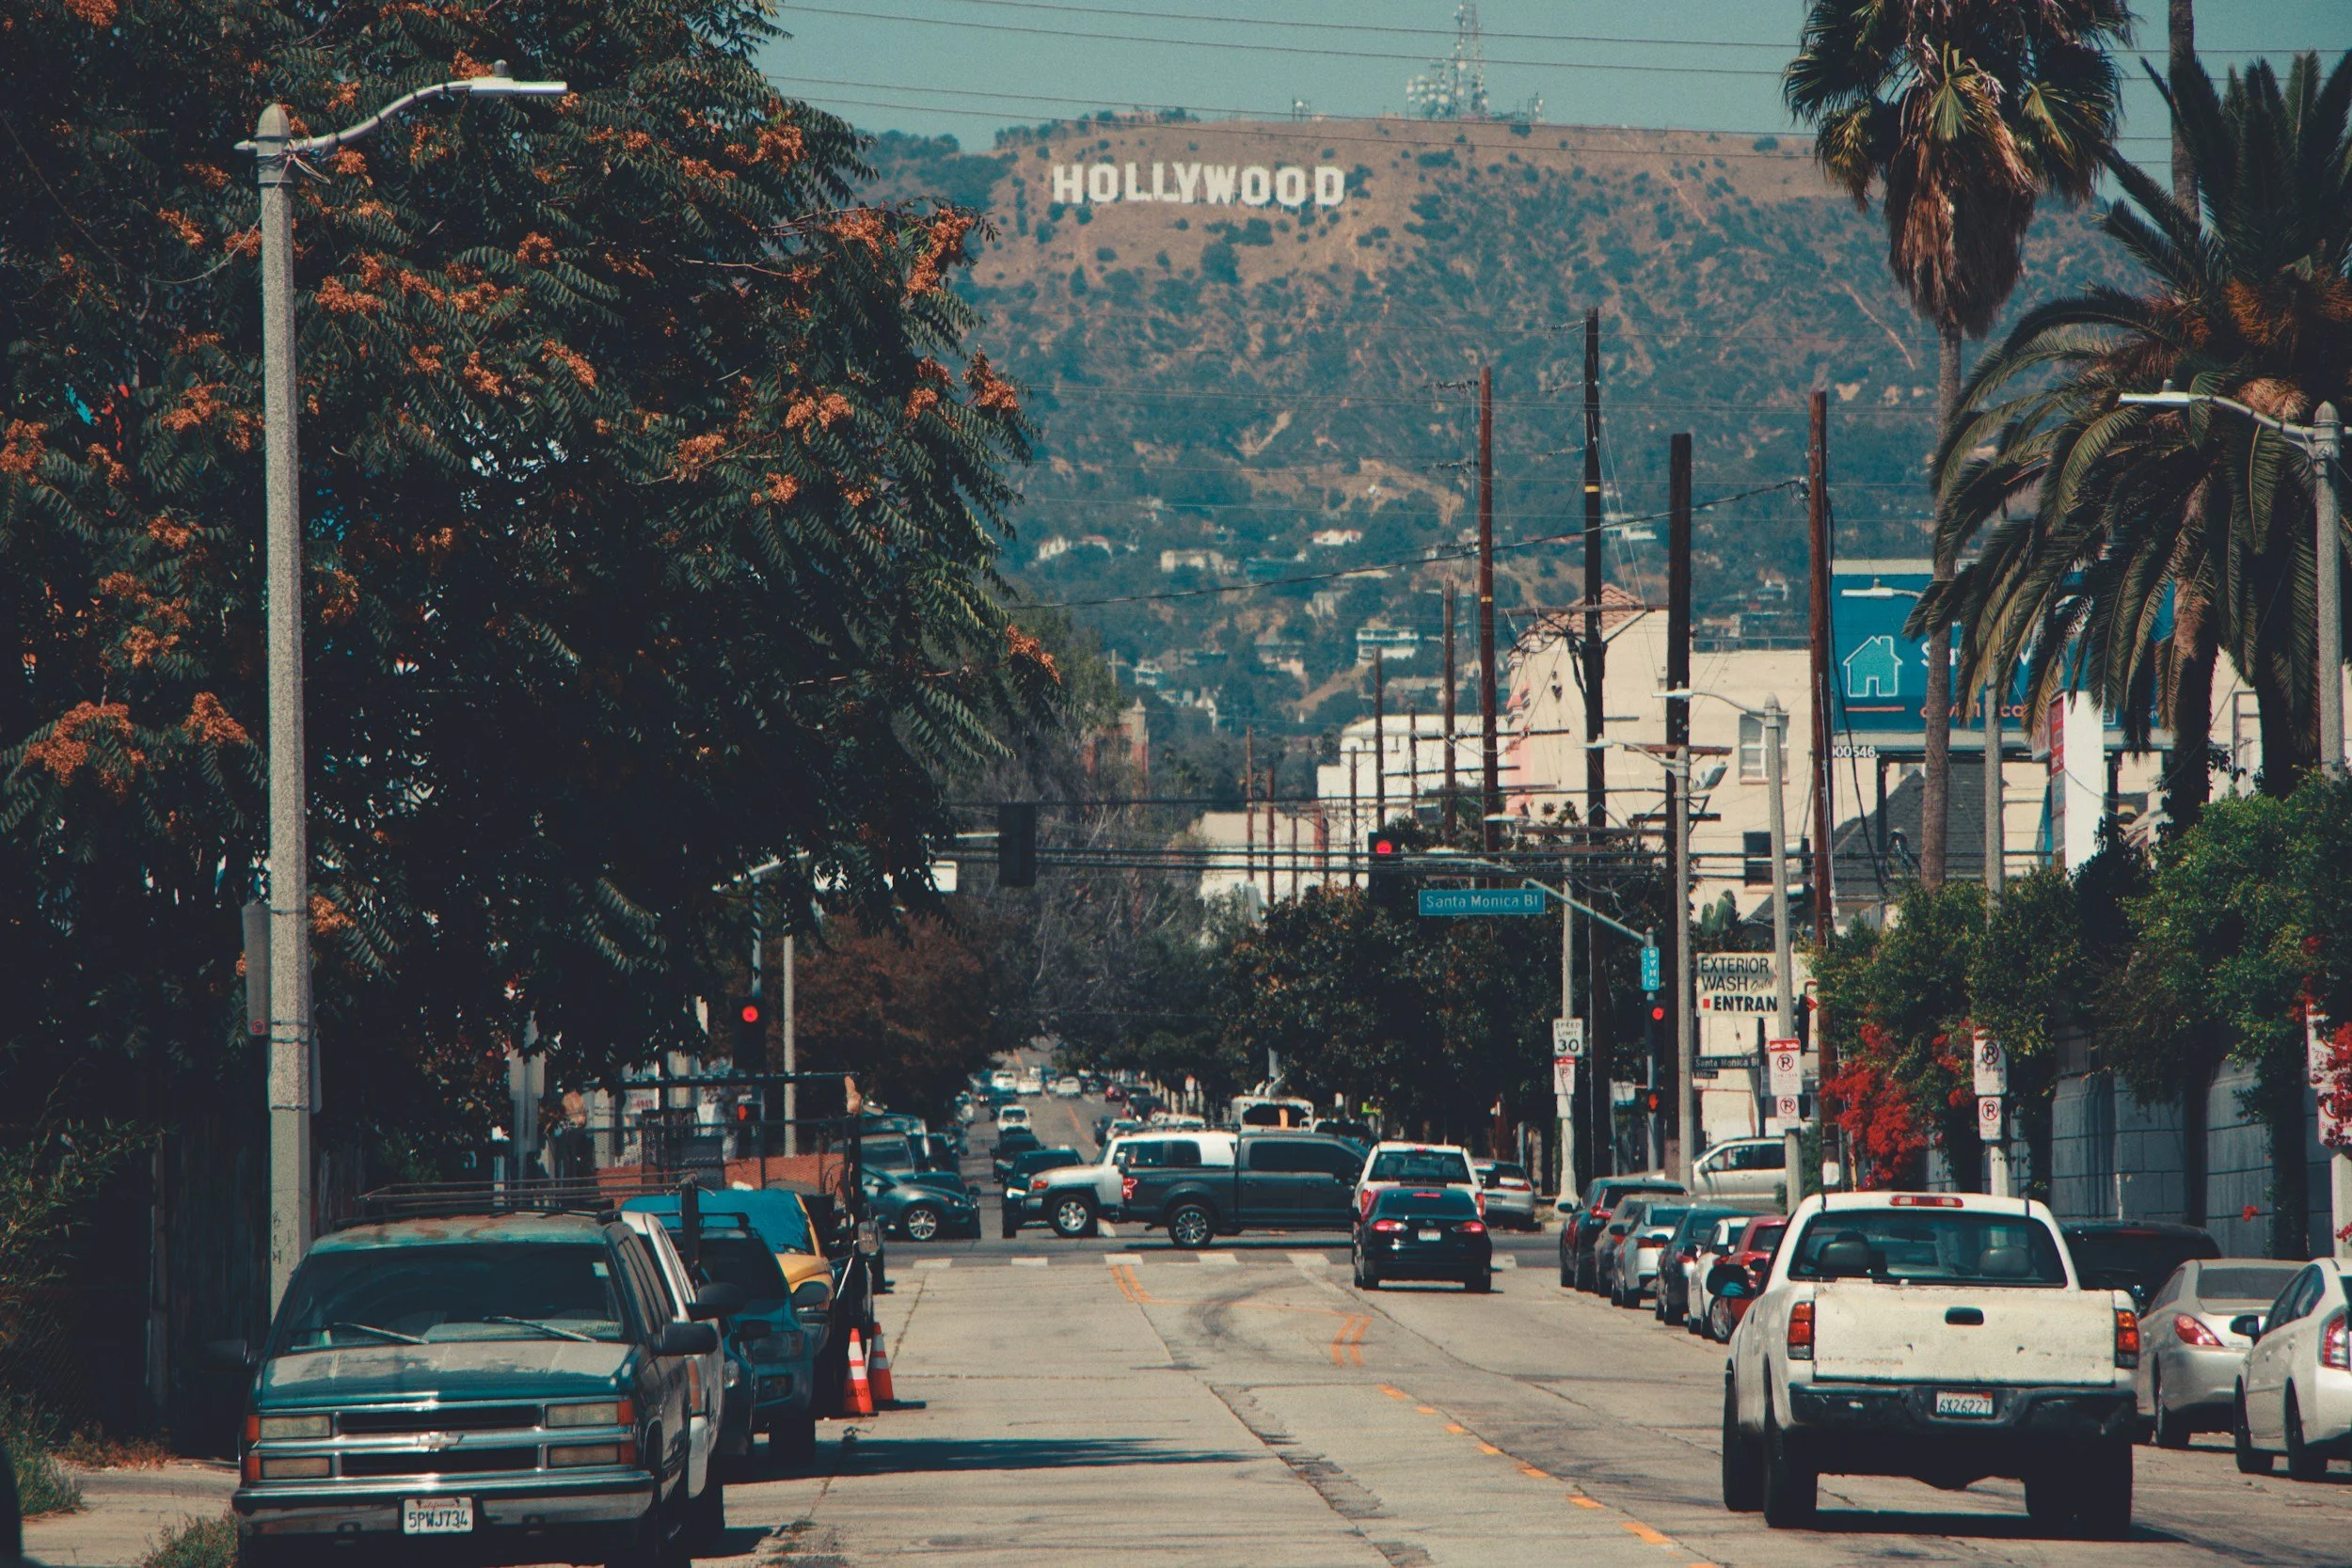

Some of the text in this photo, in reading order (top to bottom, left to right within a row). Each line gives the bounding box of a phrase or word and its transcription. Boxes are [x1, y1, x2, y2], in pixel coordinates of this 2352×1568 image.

[1053, 162, 1345, 205] HOLLYWOOD
[1426, 894, 1538, 908] Santa Monica Bl
[1701, 957, 1769, 974] EXTERIOR
[1701, 975, 1748, 991] WASH
[1714, 995, 1795, 1013] ENTRAN
[1557, 1038, 1580, 1053] 30
[1695, 1058, 1718, 1068] Santa
[1721, 1057, 1749, 1068] Monica
[1939, 1398, 1990, 1414] 6X26227
[408, 1509, 469, 1528] 5PWJ734
